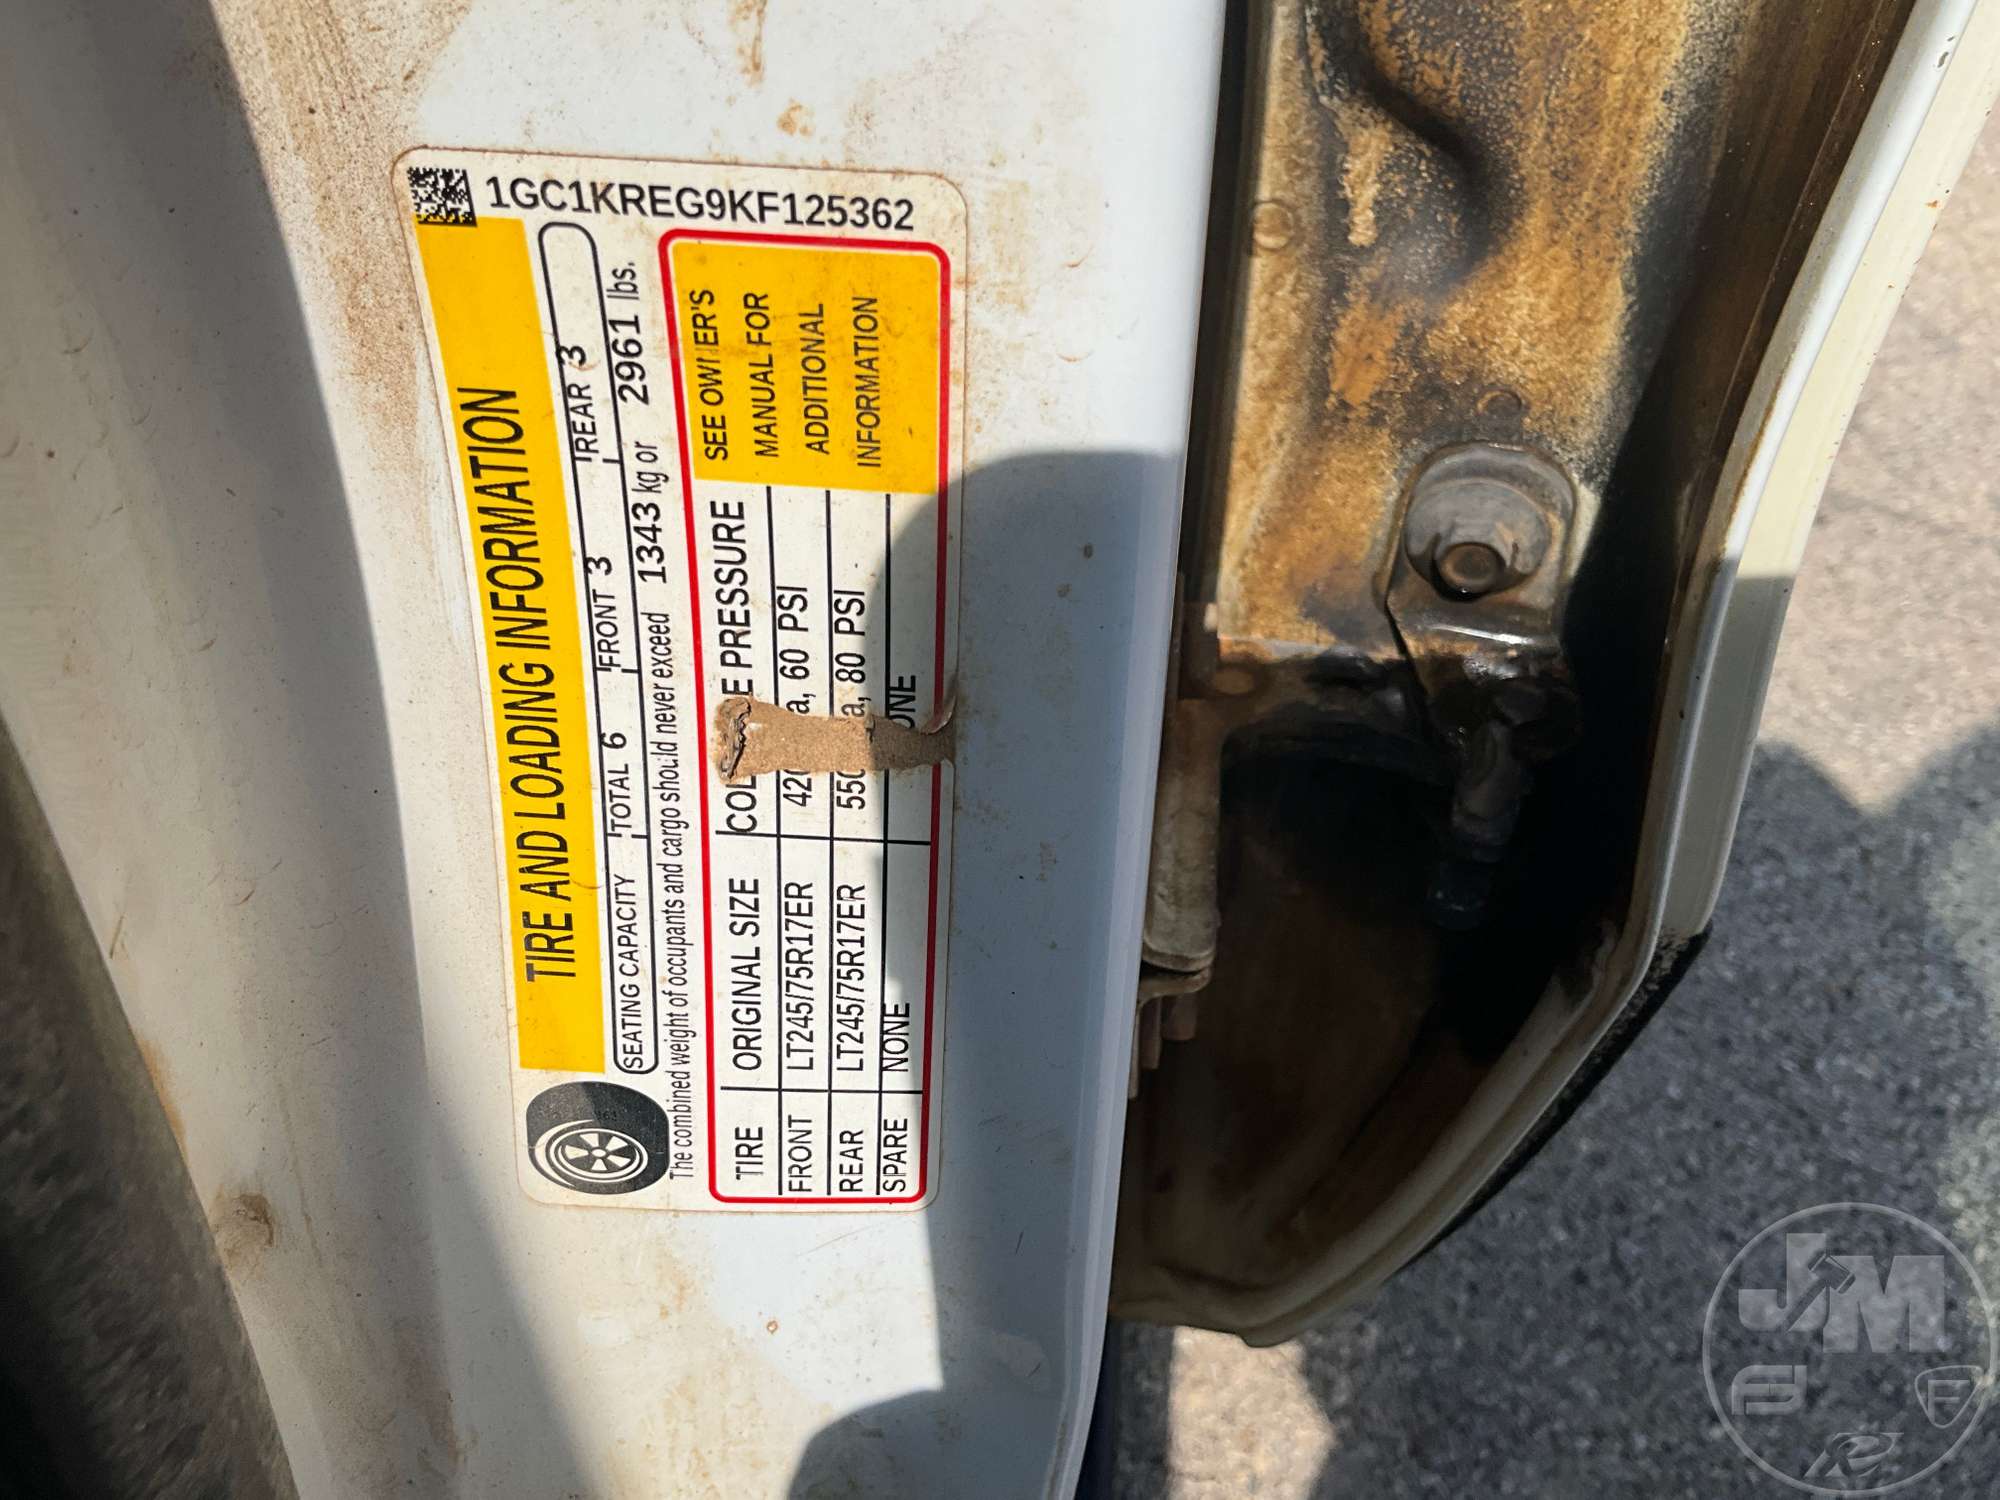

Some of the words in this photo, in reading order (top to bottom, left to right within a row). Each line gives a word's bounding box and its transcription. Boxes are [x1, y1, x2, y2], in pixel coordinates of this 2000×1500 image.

[486, 175, 914, 231] 1GC1KREG9KF125362
[606, 262, 640, 300] lbs.
[743, 292, 772, 346] FOR
[557, 345, 586, 366] 3
[608, 314, 650, 406] 2961
[798, 303, 830, 455] ADDITIONAL
[852, 296, 882, 468] INFORMATION
[568, 383, 599, 454] REAR
[702, 414, 728, 461] SEE
[748, 353, 779, 458] MANUAL
[632, 470, 670, 494] kg
[634, 441, 659, 463] or
[457, 387, 550, 650] INFORMATION
[632, 502, 667, 584] 1343
[585, 556, 613, 576] 3
[710, 500, 753, 668] PRESSURE
[592, 589, 621, 668] FRONT
[776, 585, 809, 632] PSI
[833, 589, 866, 636] PSI
[641, 611, 674, 679] exceed
[779, 648, 810, 680] 60
[834, 652, 866, 683] 80
[653, 684, 678, 735] never
[888, 675, 916, 729] ONE
[498, 663, 566, 820] LOADING
[600, 732, 627, 749] 6
[650, 741, 680, 802] should
[607, 763, 633, 832] TOTAL
[725, 774, 757, 832] COL
[660, 807, 690, 857] cargo
[516, 830, 572, 902] AND
[656, 863, 684, 894] and
[614, 874, 640, 977] CAPACITY
[728, 878, 760, 937] SIZE
[522, 911, 576, 982] TIRE
[662, 898, 694, 986] occupants
[661, 989, 688, 1007] of
[731, 946, 762, 1071] ORIGINAL
[784, 882, 814, 1071] LT245/75R17ER
[836, 884, 866, 1072] LT245/75R17ER
[620, 984, 644, 1069] SEATING
[663, 1012, 697, 1068] weight
[882, 1002, 910, 1072] NONE
[666, 1071, 692, 1147] combined
[669, 1151, 693, 1180] The
[735, 1125, 764, 1181] TIRE
[787, 1114, 813, 1193] FRONT
[839, 1128, 864, 1193] REAR
[881, 1117, 908, 1193] SPARE
